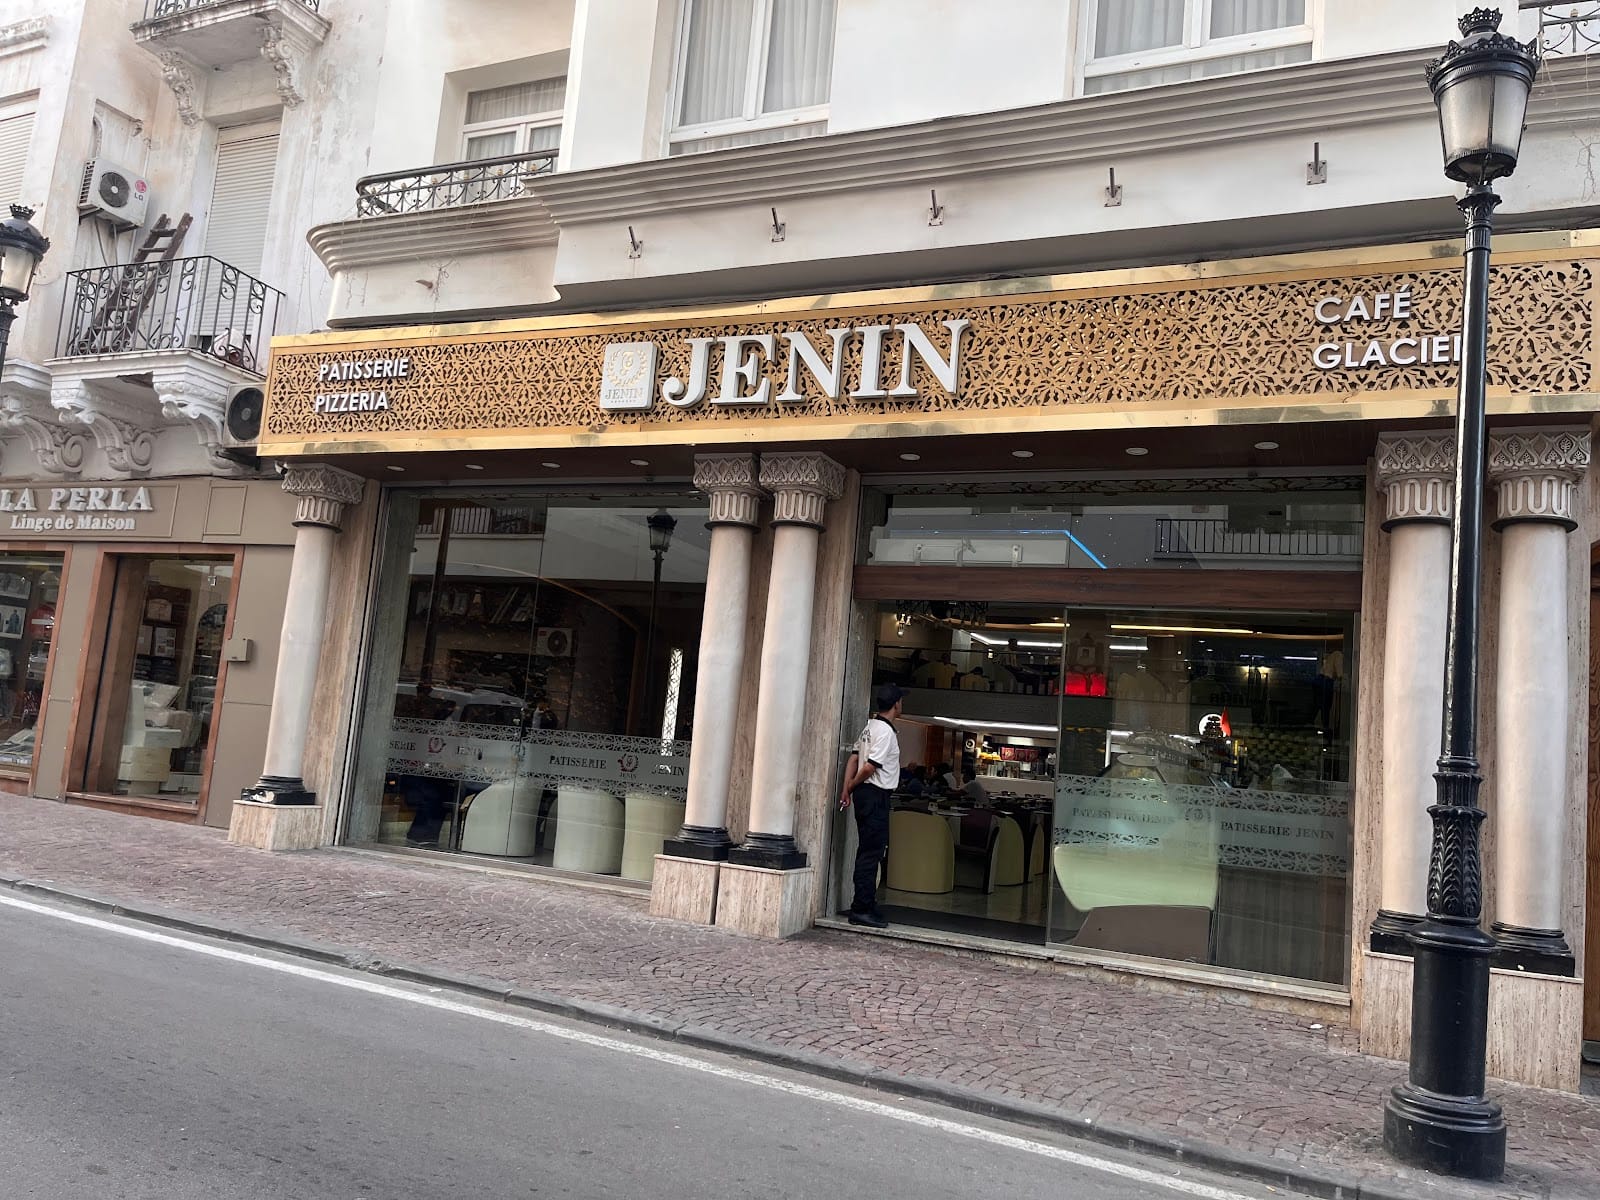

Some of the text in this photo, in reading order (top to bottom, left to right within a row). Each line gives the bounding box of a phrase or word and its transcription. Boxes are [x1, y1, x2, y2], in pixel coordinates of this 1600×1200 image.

[134, 192, 143, 201] LG
[1315, 284, 1411, 324] CAFÉ
[320, 358, 409, 381] PATISSERIE
[662, 319, 971, 408] JENIN
[315, 391, 388, 413] PIZZERIA
[605, 388, 643, 400] JENIN
[0, 486, 153, 512] LA PERLA
[10, 514, 136, 532] Linge de Maison
[549, 755, 607, 769] PATISSERIE
[1221, 821, 1334, 840] PATISSERIE JENIN
